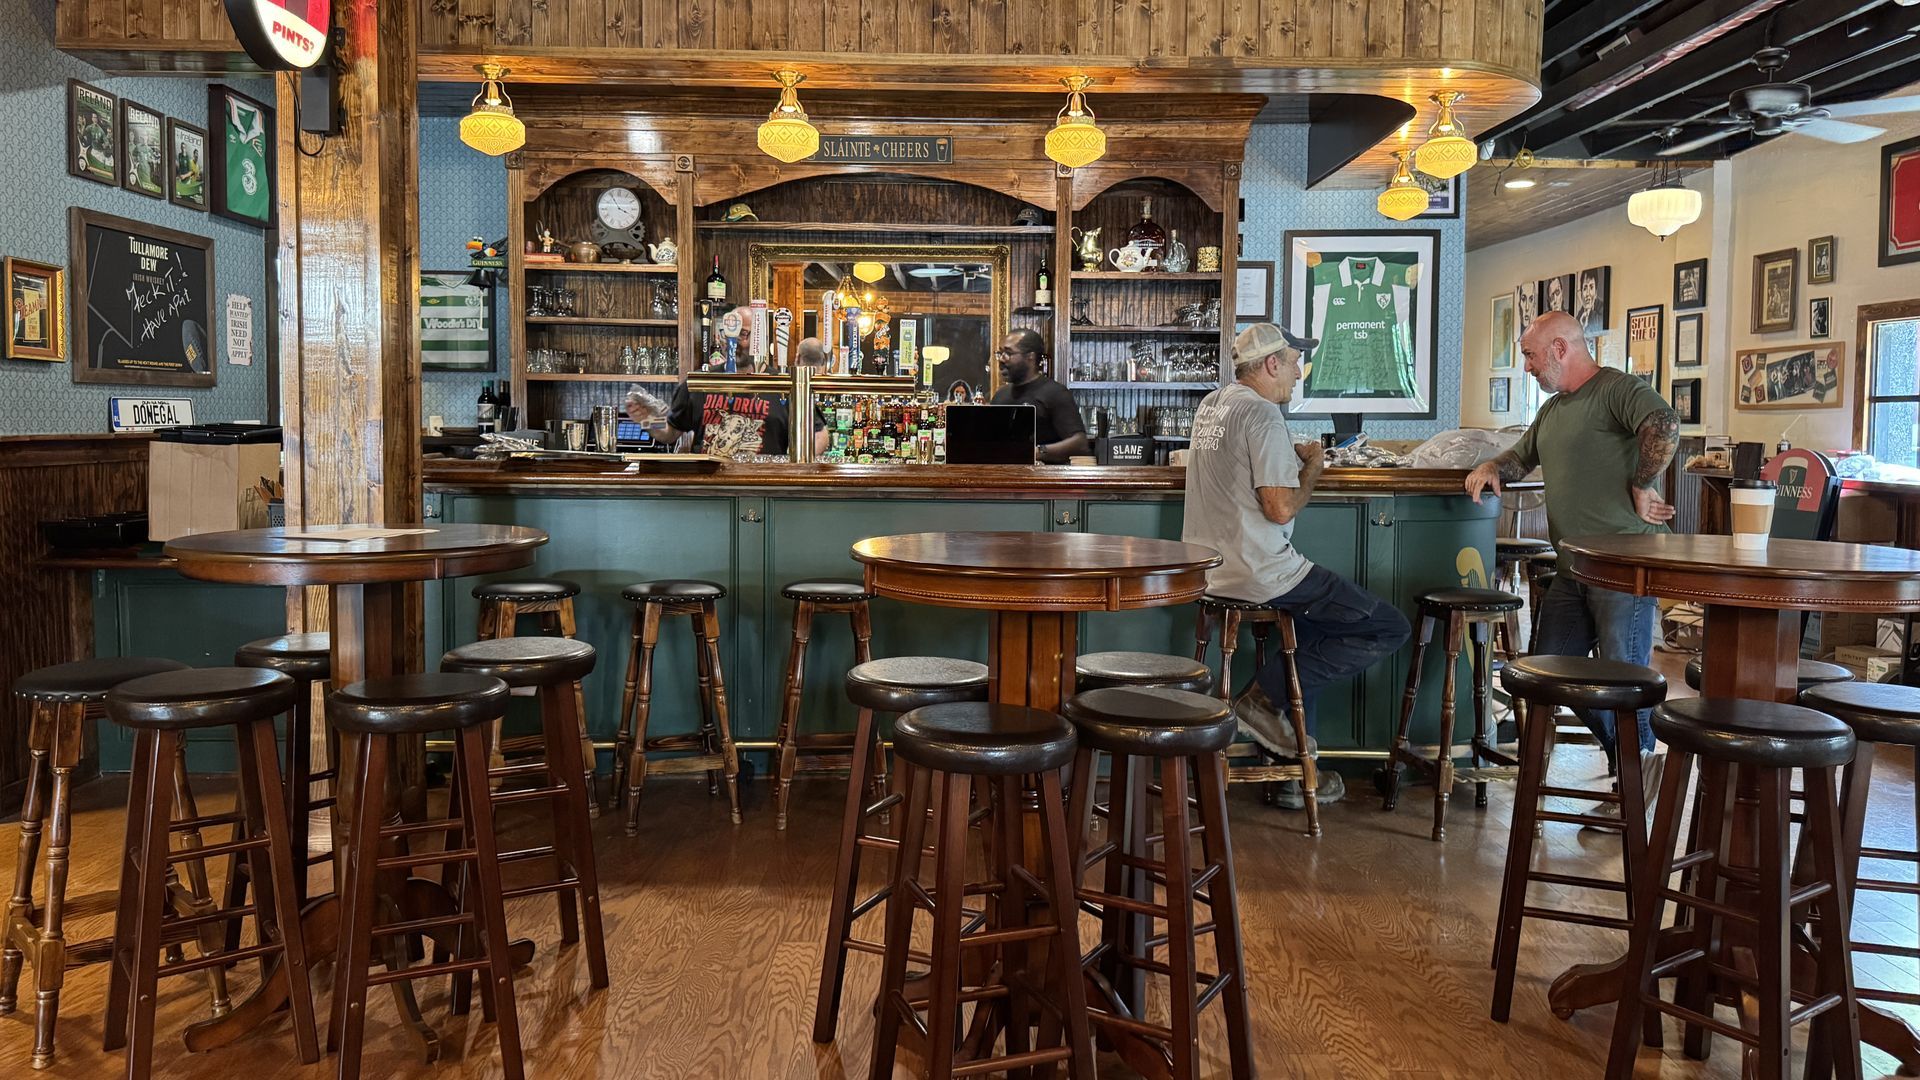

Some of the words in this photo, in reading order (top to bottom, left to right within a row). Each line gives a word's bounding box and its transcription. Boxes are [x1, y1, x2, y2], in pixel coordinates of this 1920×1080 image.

[272, 21, 315, 54] PINTS?
[823, 138, 871, 157] SLÁINTE
[881, 142, 929, 158] CHEERS
[128, 236, 169, 260] TULLAMORE
[140, 257, 157, 272] DEW
[132, 273, 145, 282] IRISH
[231, 301, 247, 311] HELP
[231, 320, 248, 330] IRISH
[1336, 320, 1386, 332] permanent
[231, 329, 248, 338] NEED
[1353, 330, 1368, 339] tsb
[1649, 327, 1656, 340] G
[232, 338, 245, 347] NOT
[231, 349, 248, 358] APPLY
[703, 394, 729, 410] DIAL
[733, 397, 769, 415] DRIVE
[133, 405, 180, 424] DONEGAL
[1113, 445, 1144, 455] SLANE
[1775, 484, 1813, 499] UINNESS
